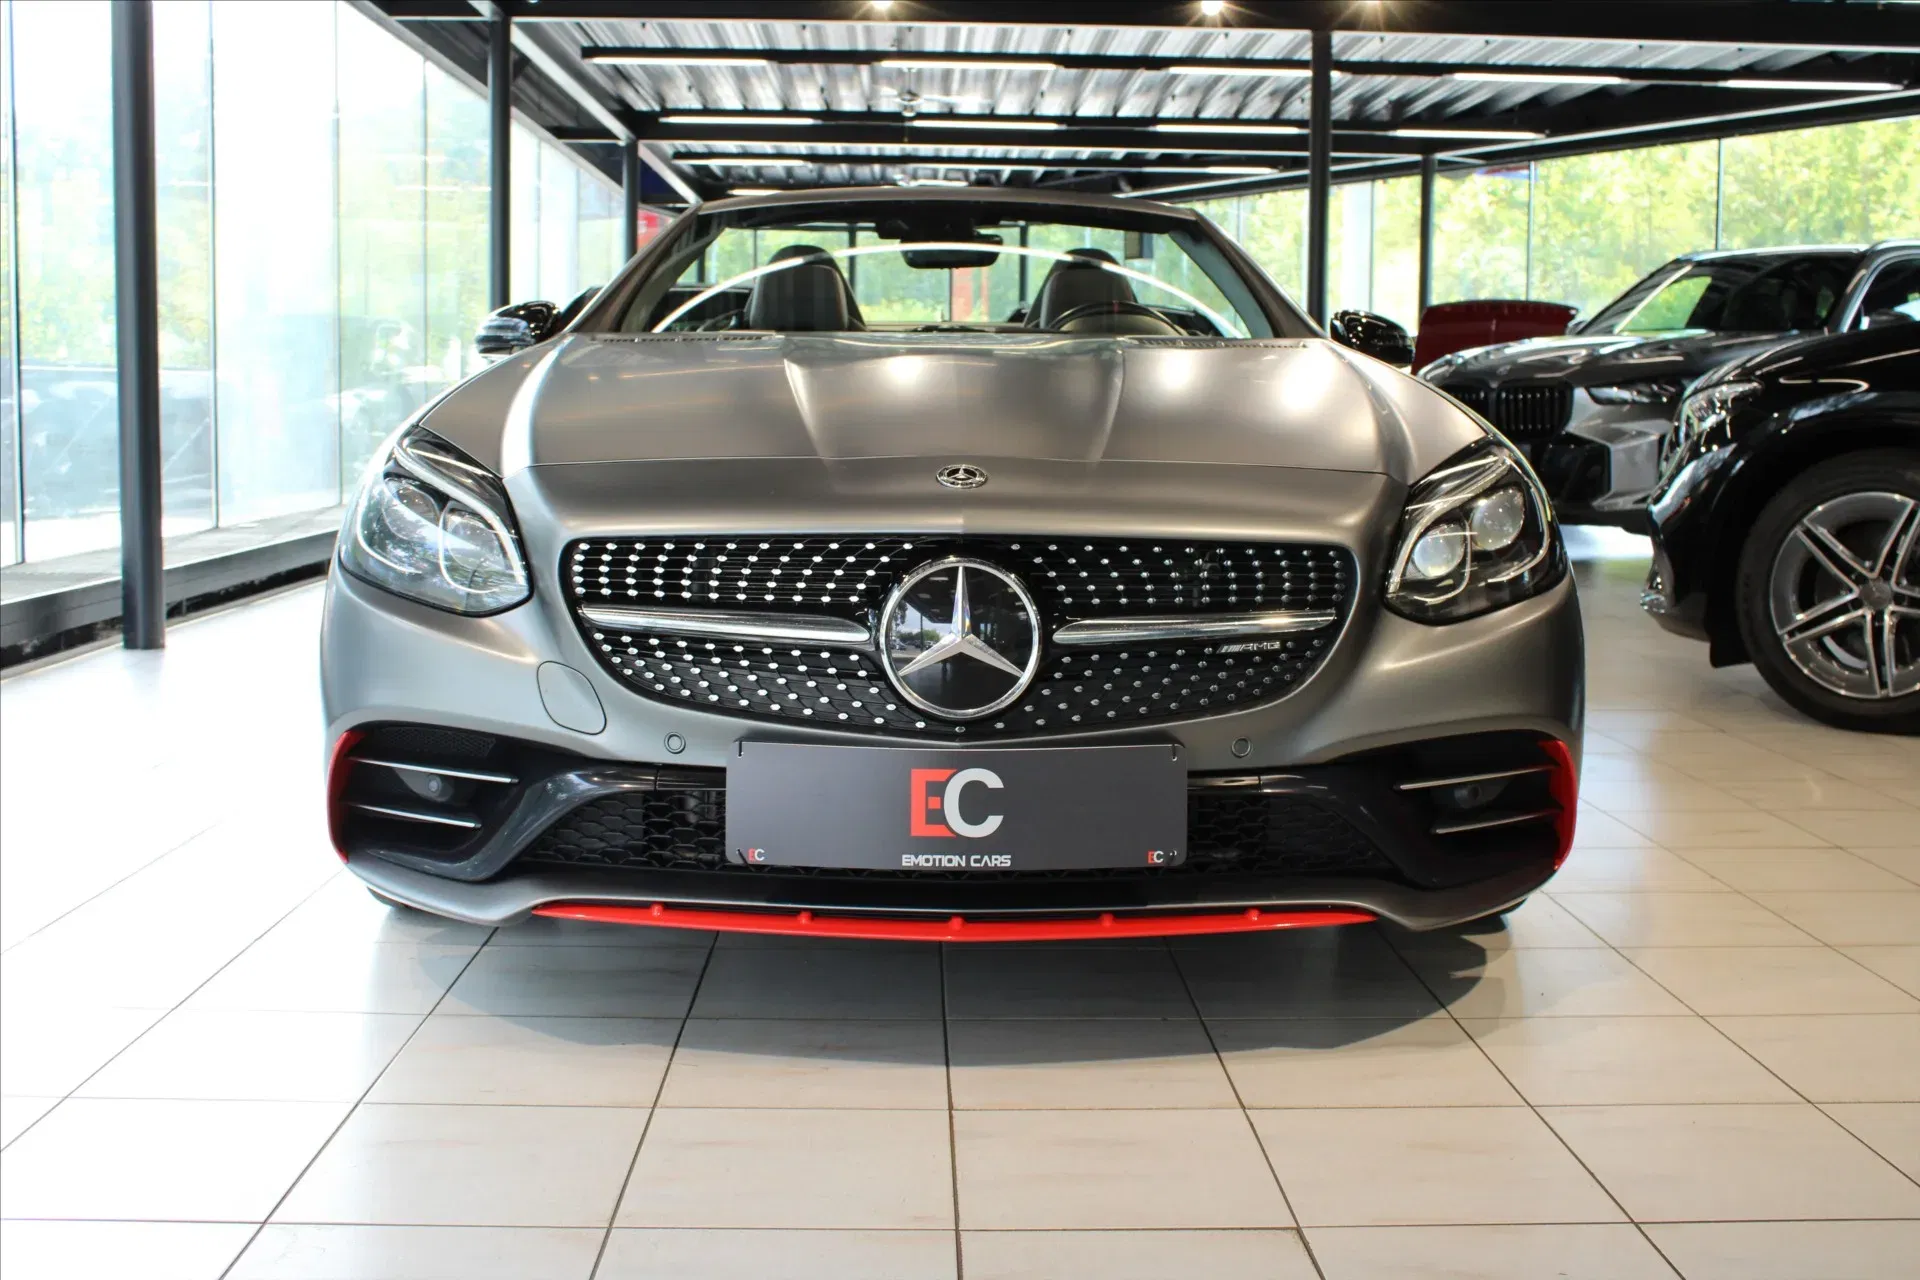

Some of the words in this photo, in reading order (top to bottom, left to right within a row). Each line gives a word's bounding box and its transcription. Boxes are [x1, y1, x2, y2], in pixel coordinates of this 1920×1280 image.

[910, 767, 1005, 838] EC
[901, 854, 966, 867] EMOTION
[970, 854, 1012, 867] CARS
[1147, 850, 1164, 864] EC
